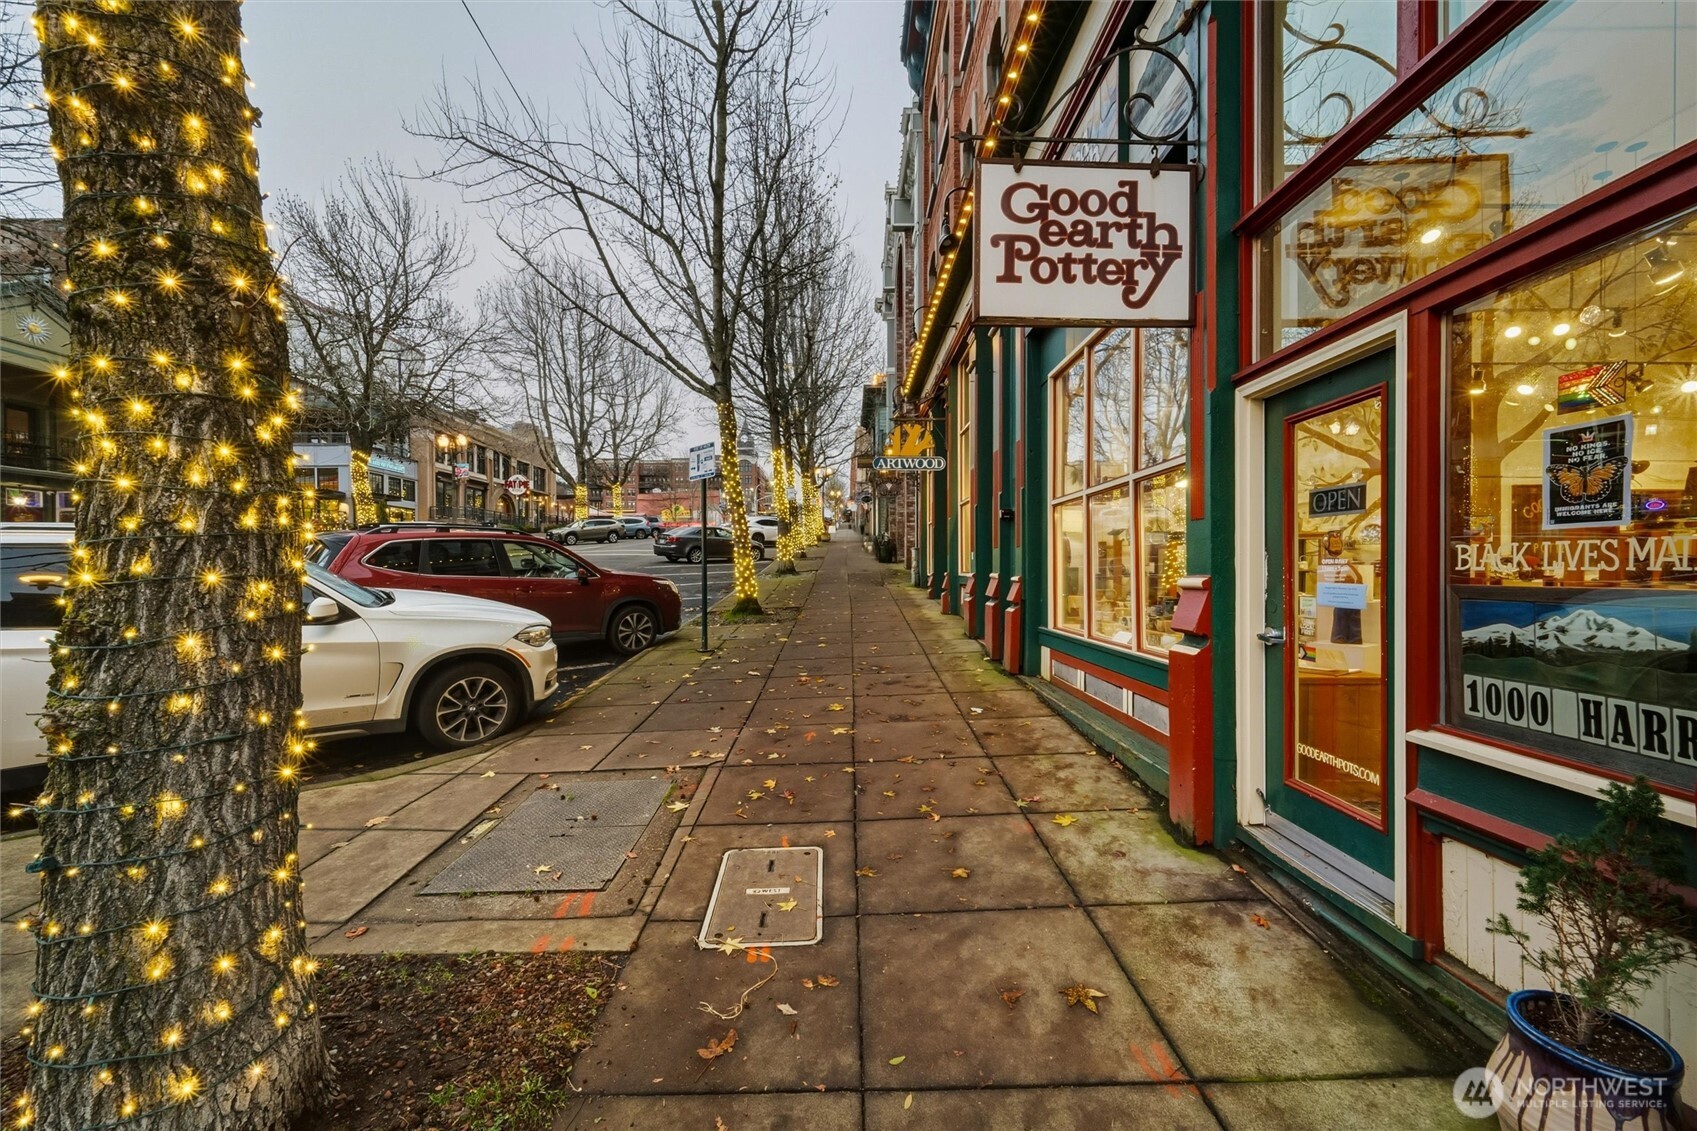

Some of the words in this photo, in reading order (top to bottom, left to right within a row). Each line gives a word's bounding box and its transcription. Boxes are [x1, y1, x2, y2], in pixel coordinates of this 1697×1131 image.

[1001, 180, 1143, 224] Good
[1039, 212, 1183, 251] earth
[990, 234, 1182, 309] Pottery
[876, 458, 944, 469] ARTWOOD
[1566, 445, 1578, 453] NO
[1581, 441, 1611, 450] KINGS.
[1583, 453, 1608, 462] FEAR.
[1313, 488, 1360, 512] OPEN
[1556, 508, 1592, 517] WELCOME
[1455, 541, 1532, 571] BLACK
[1542, 538, 1619, 571] LIVES
[1626, 535, 1697, 571] MAT
[1467, 680, 1549, 726] 1000
[1297, 743, 1380, 786] GOODEARTHPOTS.COM
